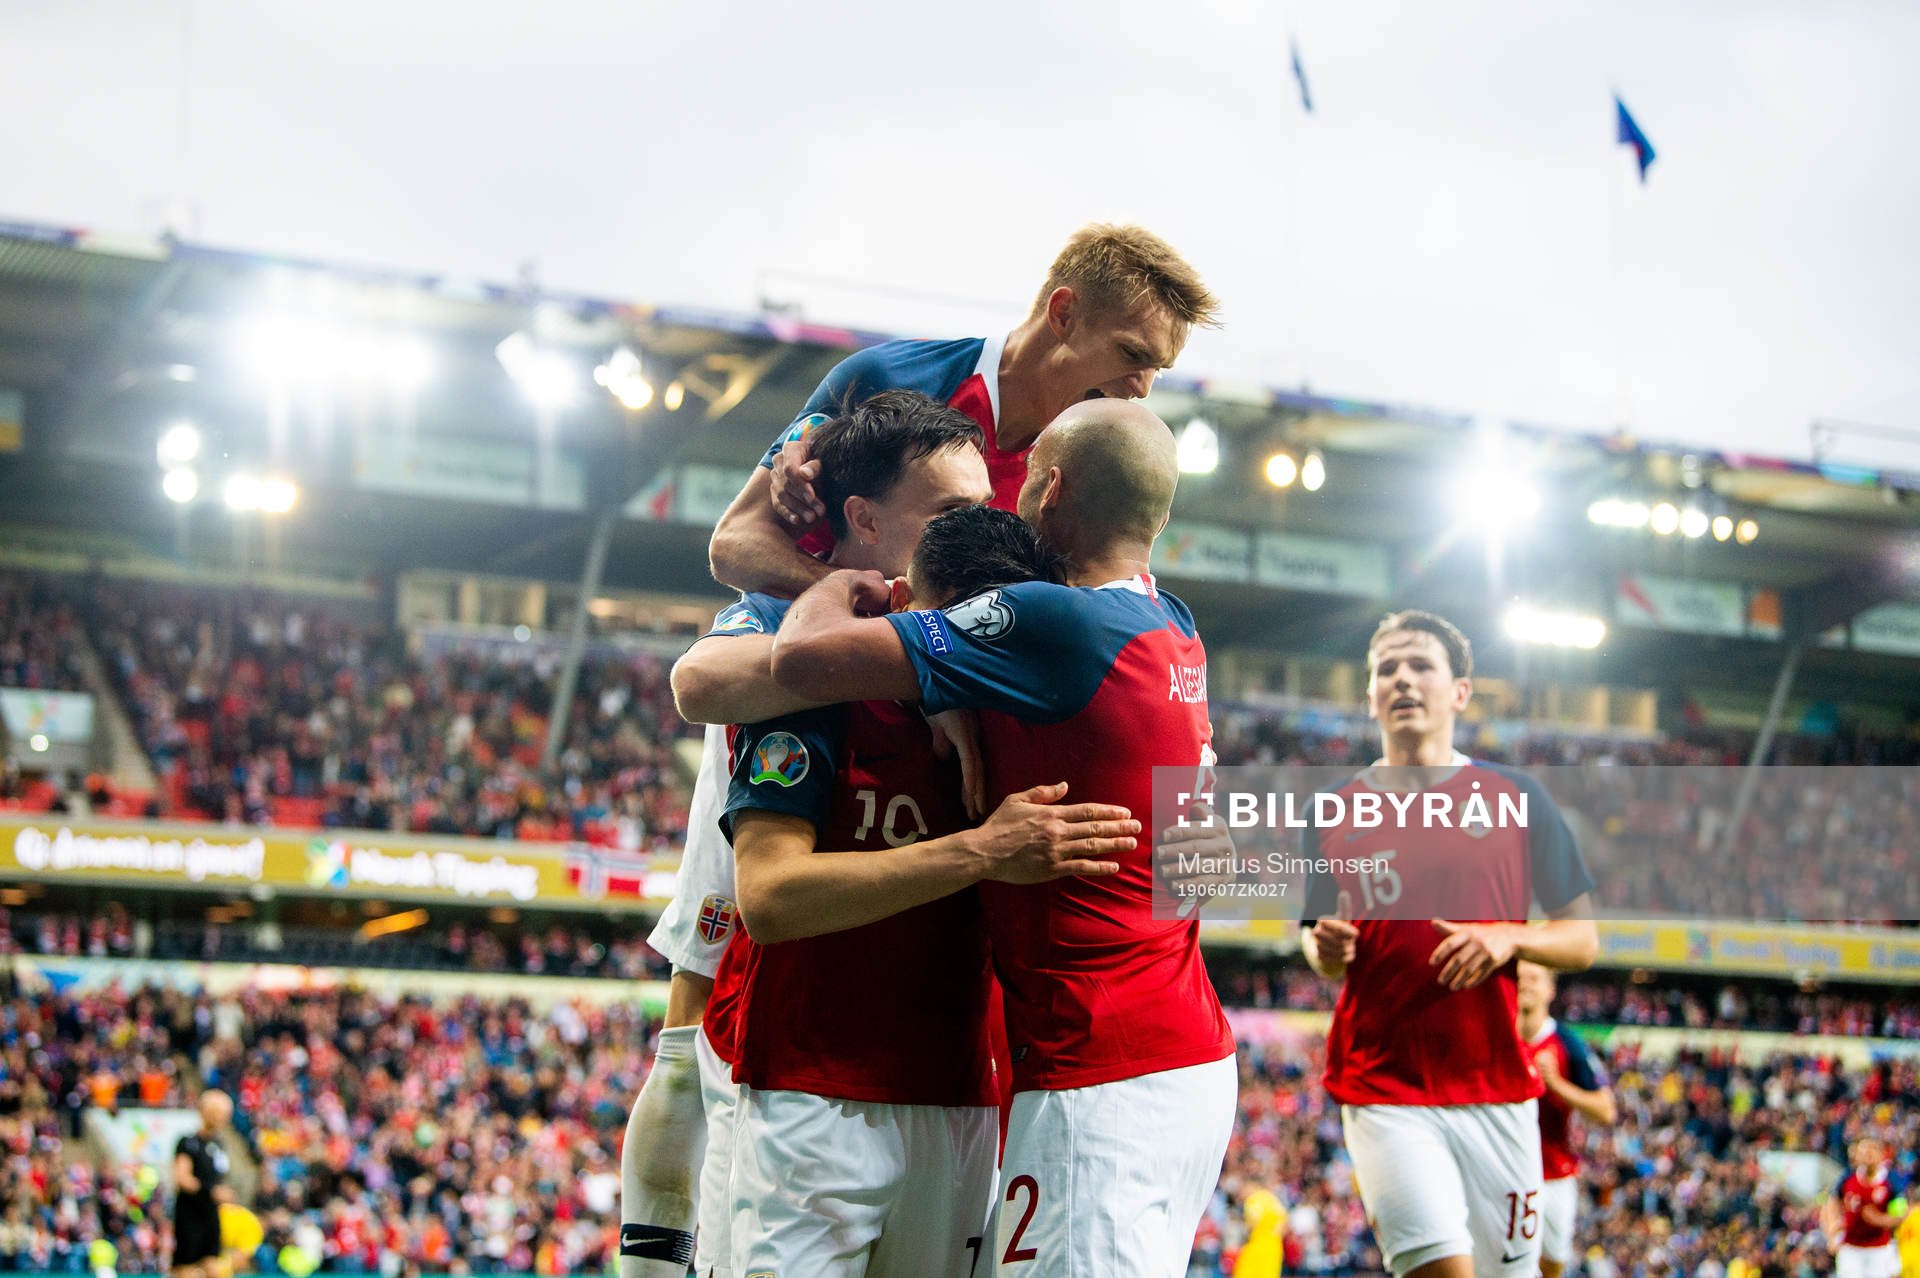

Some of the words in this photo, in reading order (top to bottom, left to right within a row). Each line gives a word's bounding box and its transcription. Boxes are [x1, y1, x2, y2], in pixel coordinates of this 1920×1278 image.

[920, 610, 948, 653] ESPECT
[855, 790, 928, 848] 10
[1354, 849, 1402, 910] 15
[1002, 1174, 1039, 1264] 2
[1507, 1190, 1538, 1240] 15
